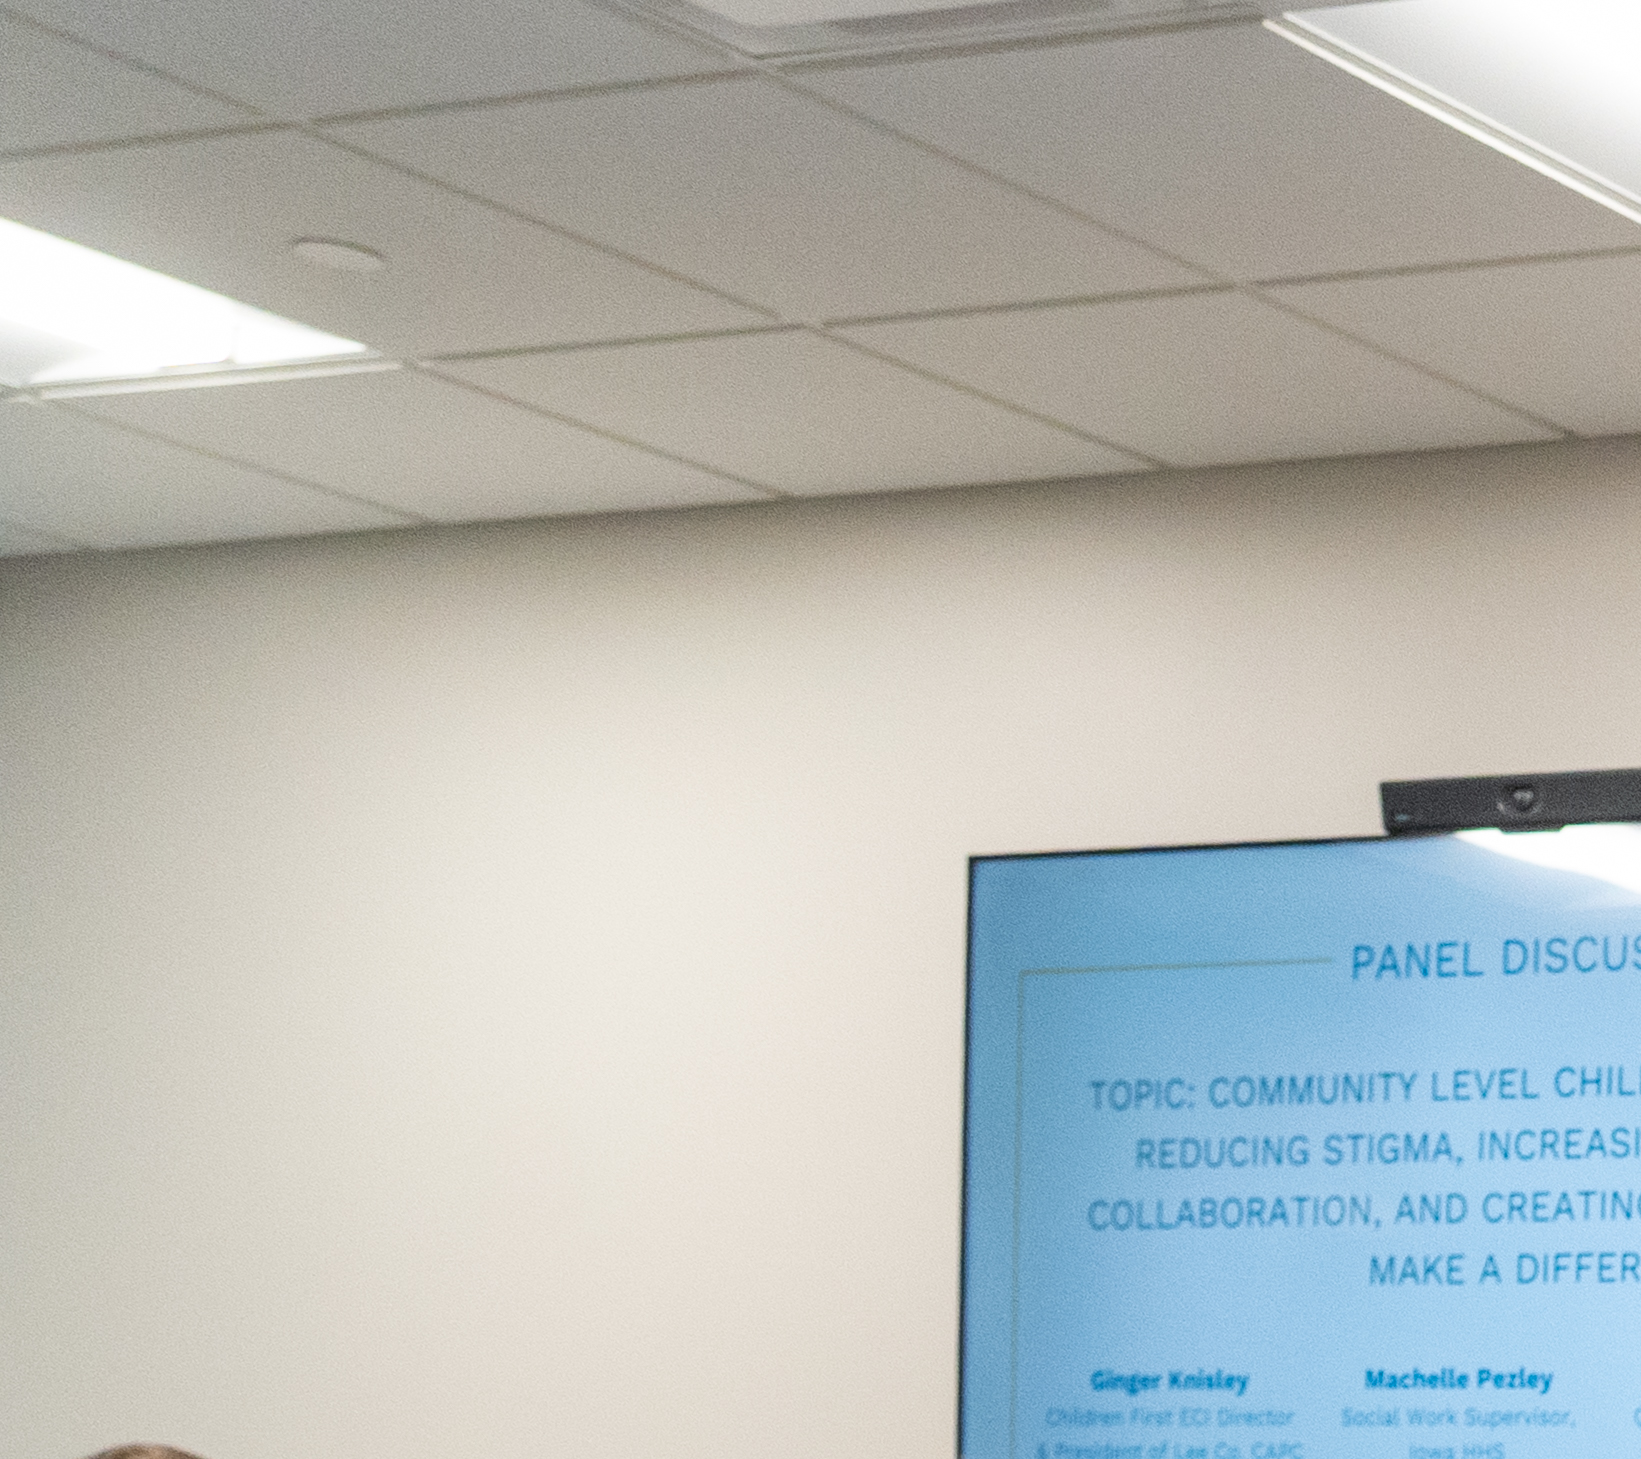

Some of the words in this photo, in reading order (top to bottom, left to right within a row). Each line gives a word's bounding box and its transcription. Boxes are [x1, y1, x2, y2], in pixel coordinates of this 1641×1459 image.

[1352, 941, 1484, 981] PANEL
[1089, 1076, 1197, 1111] TOPIC:
[1208, 1070, 1418, 1109] COMMUNITY
[1431, 1067, 1539, 1103] LEVEL
[1134, 1134, 1310, 1169] REDUCING
[1323, 1131, 1463, 1166] STIGMA,
[1086, 1193, 1382, 1231] COLLABORATION,
[1394, 1191, 1468, 1225] AND
[1368, 1252, 1466, 1287] MAKE
[1478, 1252, 1503, 1286] A
[1090, 1368, 1162, 1396] Ginger
[1365, 1367, 1469, 1390] Machelle
[1476, 1366, 1554, 1395] Pezley
[1340, 1406, 1400, 1428] Social
[1407, 1407, 1456, 1427] Work
